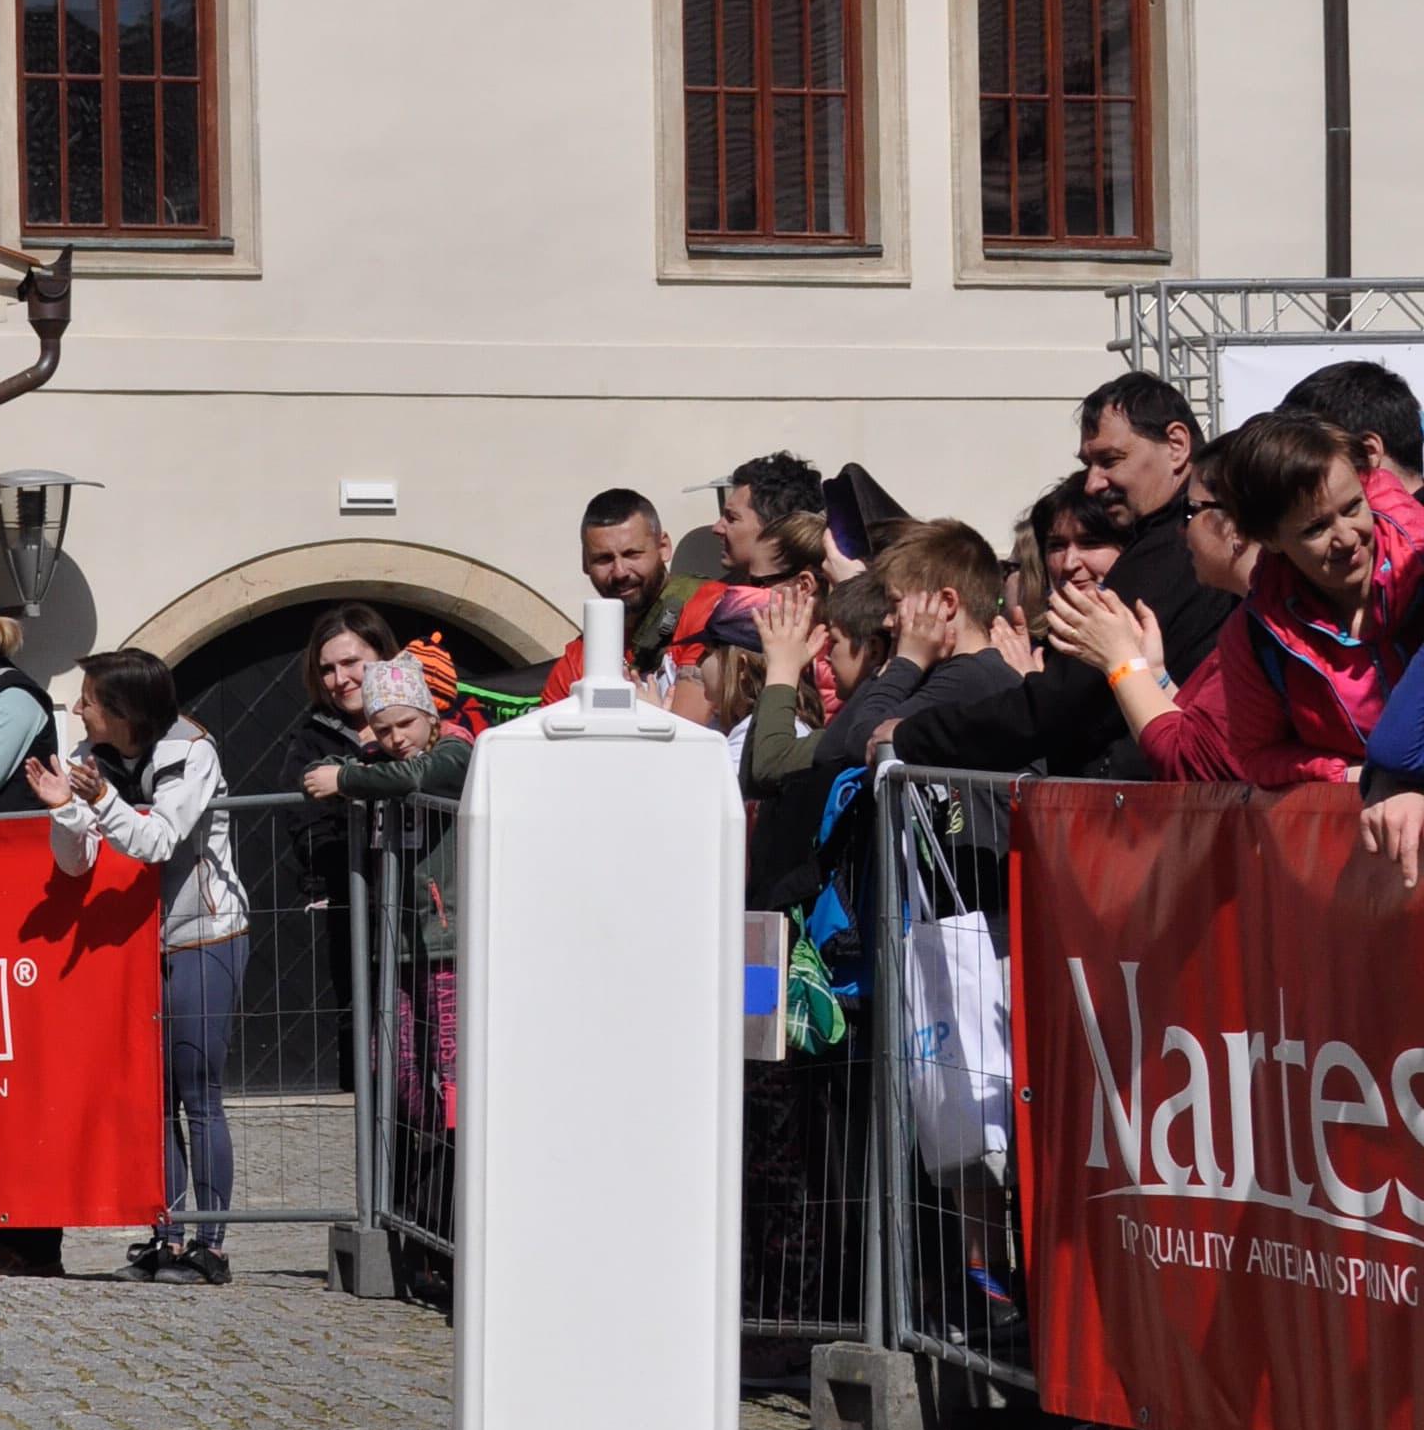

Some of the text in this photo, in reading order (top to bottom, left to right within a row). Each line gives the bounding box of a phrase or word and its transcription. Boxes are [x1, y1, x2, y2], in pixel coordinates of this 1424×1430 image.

[1142, 1224, 1235, 1271] QUALITY
[1246, 1237, 1334, 1292] ARTEIAN
[1335, 1255, 1419, 1307] SPRING
